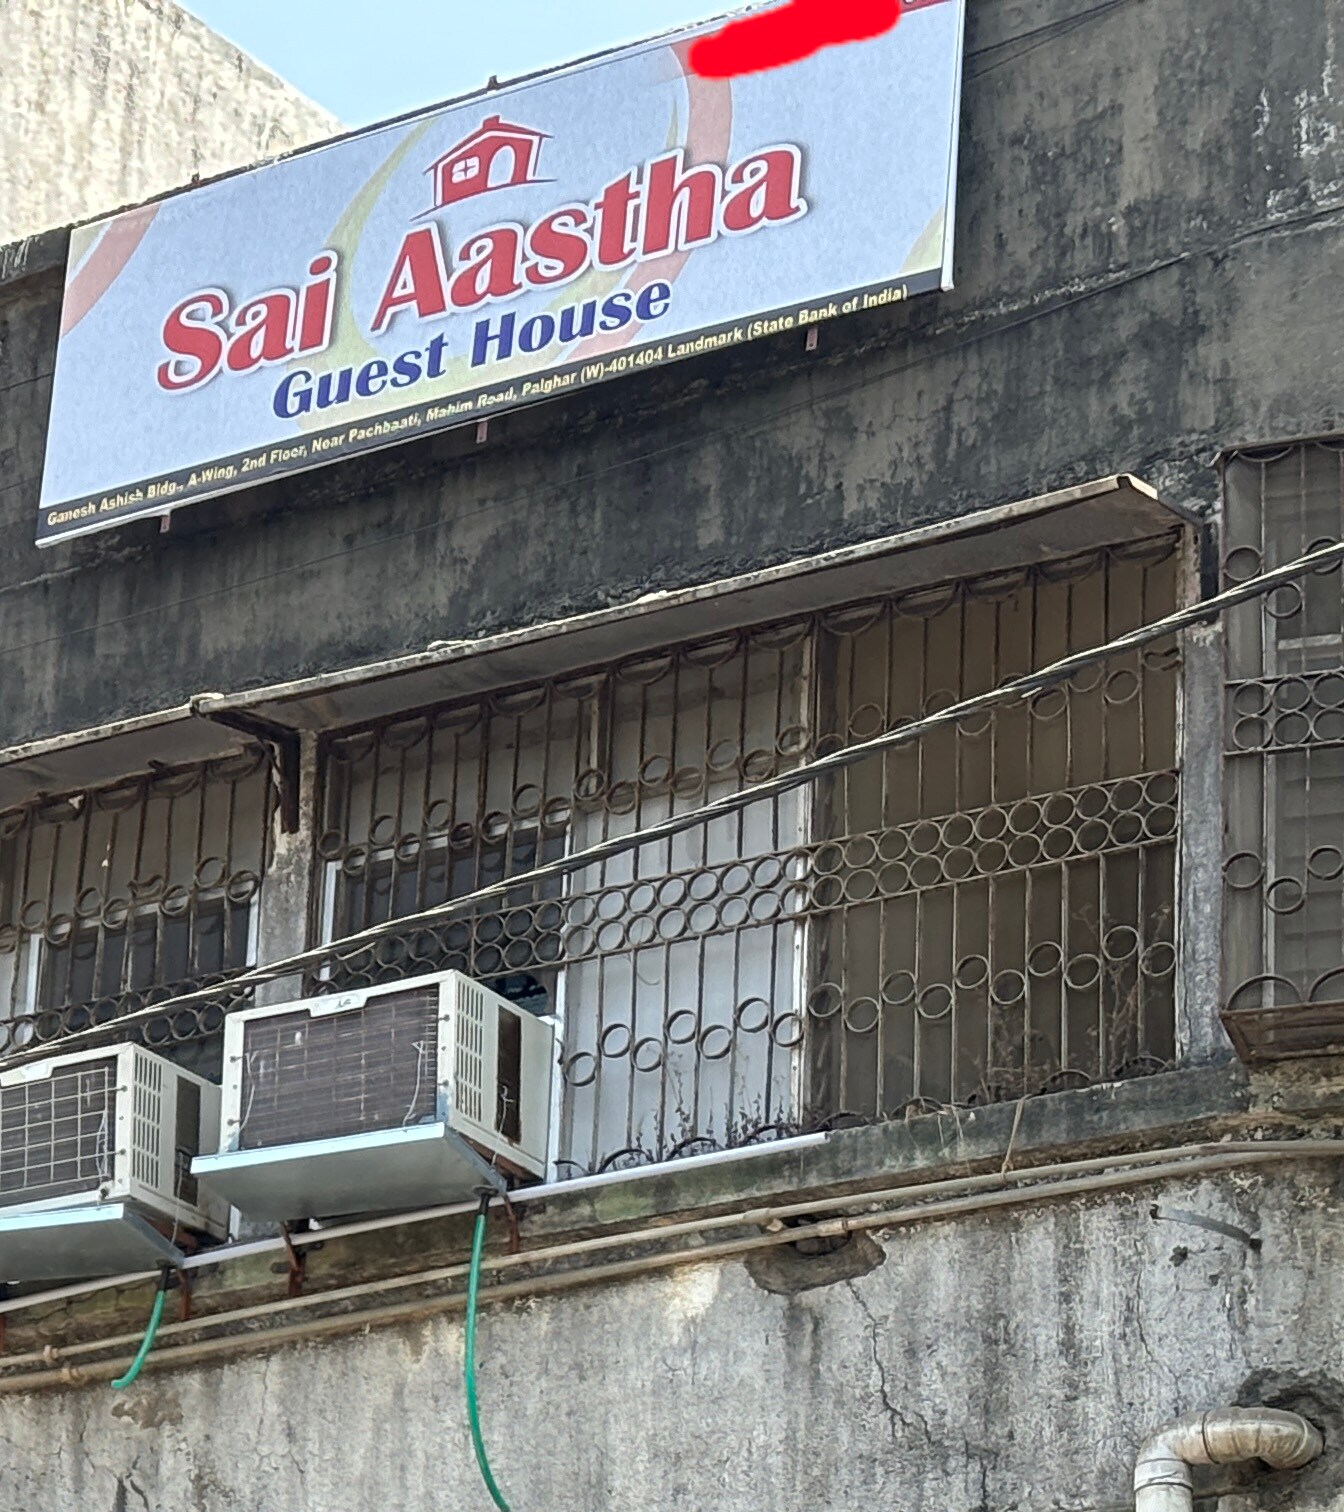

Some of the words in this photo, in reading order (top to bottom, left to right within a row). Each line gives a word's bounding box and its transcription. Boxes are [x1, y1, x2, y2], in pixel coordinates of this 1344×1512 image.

[157, 258, 337, 391] Sai
[371, 147, 805, 332] Aastha
[273, 333, 448, 420] Guest
[471, 281, 671, 368] House
[47, 505, 96, 526] Ganesh
[99, 488, 144, 512] Ashish
[241, 449, 266, 471] 2nd
[311, 432, 345, 453] Near
[426, 400, 473, 422] Mahim
[522, 372, 576, 398] Palghar
[580, 347, 664, 384] (W)-401404
[667, 327, 743, 358] Landmark
[747, 318, 794, 342] (State
[799, 303, 838, 324] Bank
[842, 296, 859, 313] of
[862, 284, 909, 309] India)
